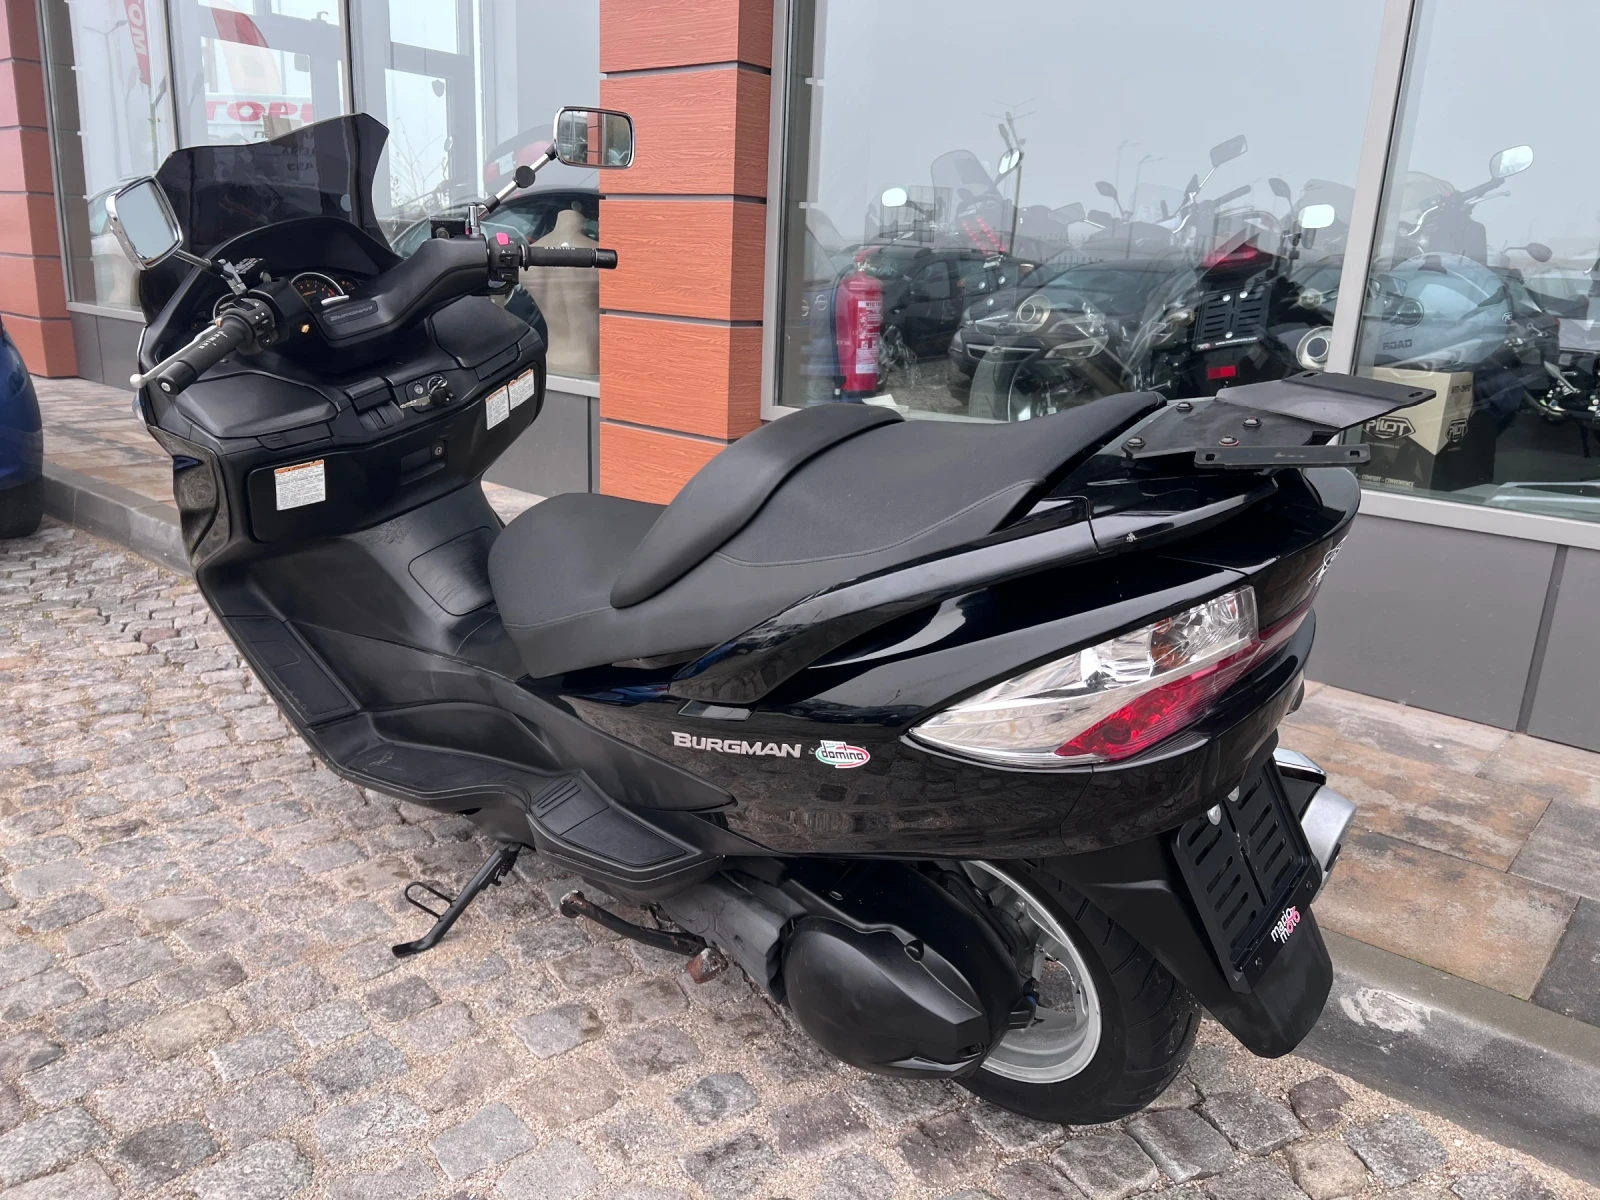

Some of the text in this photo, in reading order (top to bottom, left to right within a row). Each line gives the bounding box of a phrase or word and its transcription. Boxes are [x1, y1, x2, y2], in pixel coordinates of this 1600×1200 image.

[1383, 339, 1412, 350] ROAD
[671, 731, 802, 759] BURGMAN
[821, 742, 864, 760] domino
[1270, 907, 1293, 942] mario
